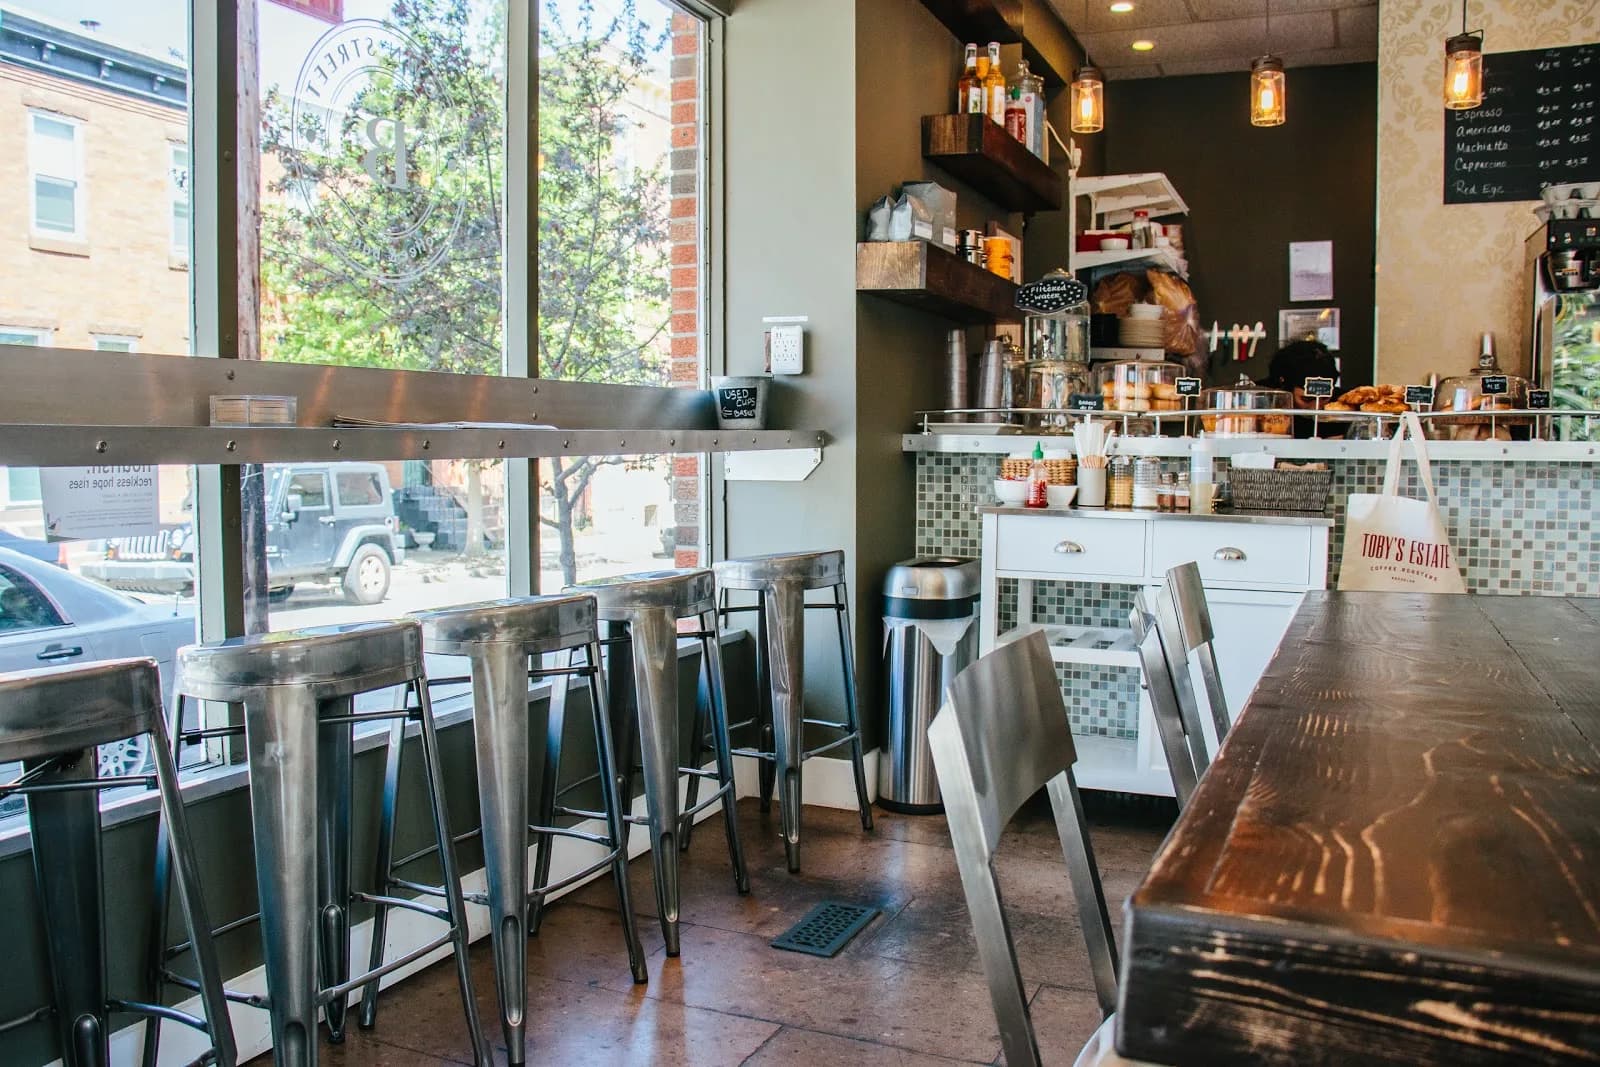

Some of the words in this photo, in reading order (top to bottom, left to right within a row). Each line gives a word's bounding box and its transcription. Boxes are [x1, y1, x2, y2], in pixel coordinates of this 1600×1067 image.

[1455, 108, 1503, 123] Espresso
[1456, 180, 1478, 195] Red
[725, 389, 748, 399] USED
[736, 398, 755, 407] CUPS
[1362, 533, 1405, 562] TOBY'S
[1409, 540, 1450, 569] ESTATE
